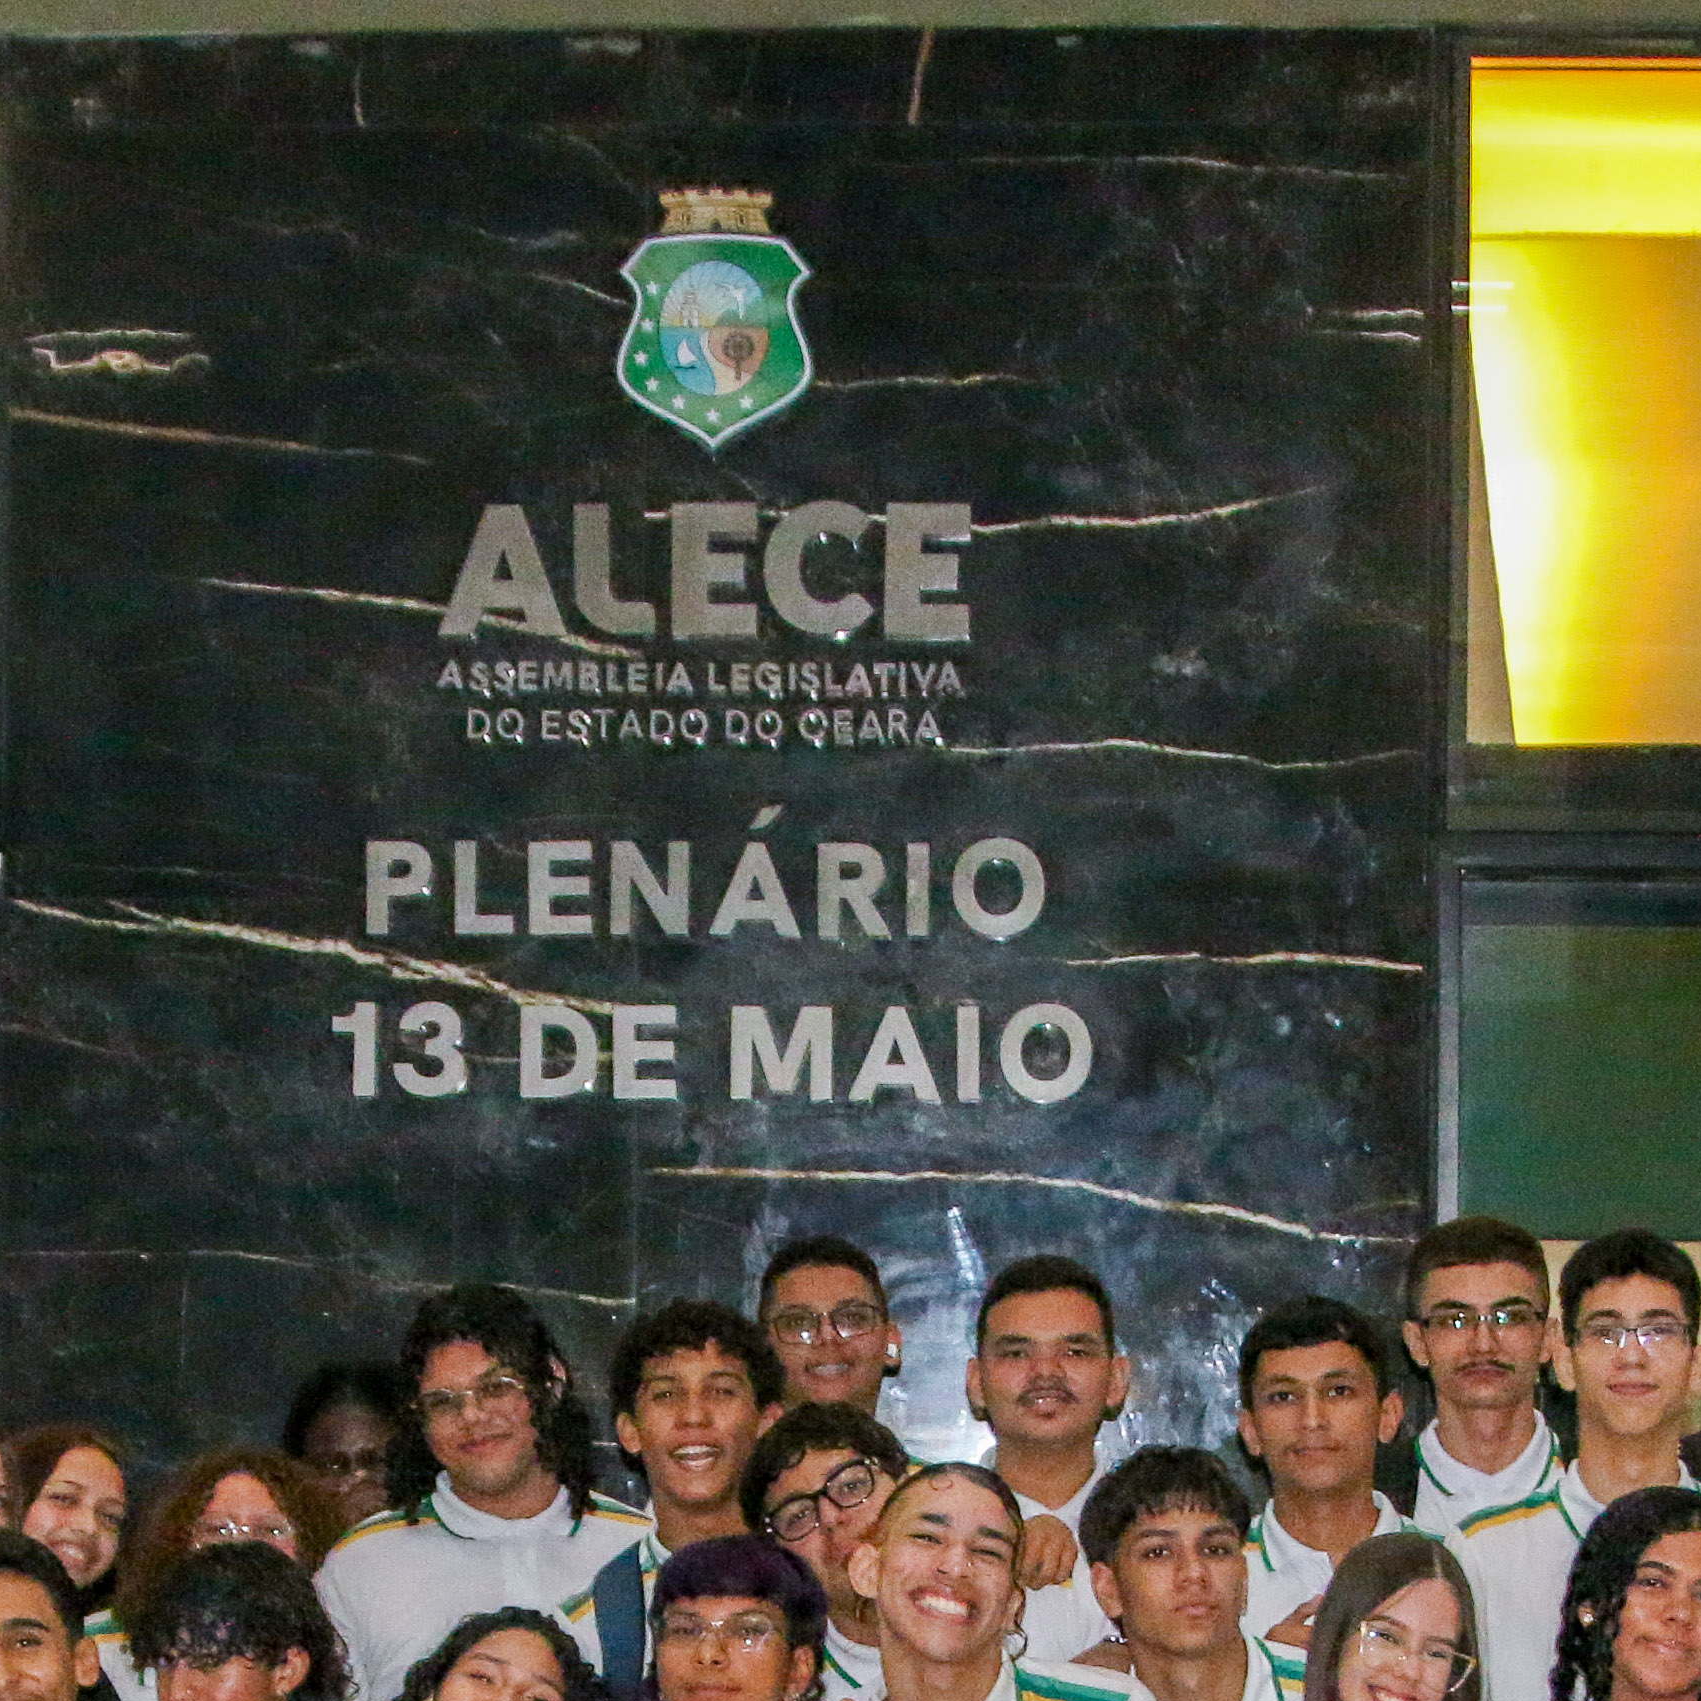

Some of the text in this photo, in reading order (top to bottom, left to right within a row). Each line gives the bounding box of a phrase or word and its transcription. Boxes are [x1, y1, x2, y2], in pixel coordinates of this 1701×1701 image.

[437, 499, 973, 644] ALECE
[436, 659, 966, 698] ASSEMBLEIA LEGISLATIVA
[466, 707, 525, 743] DO
[541, 707, 709, 745] ESTADO
[725, 708, 784, 745] DO
[364, 804, 1047, 942] PLENÁRIO
[330, 1000, 1095, 1106] 13 DE MAIO
